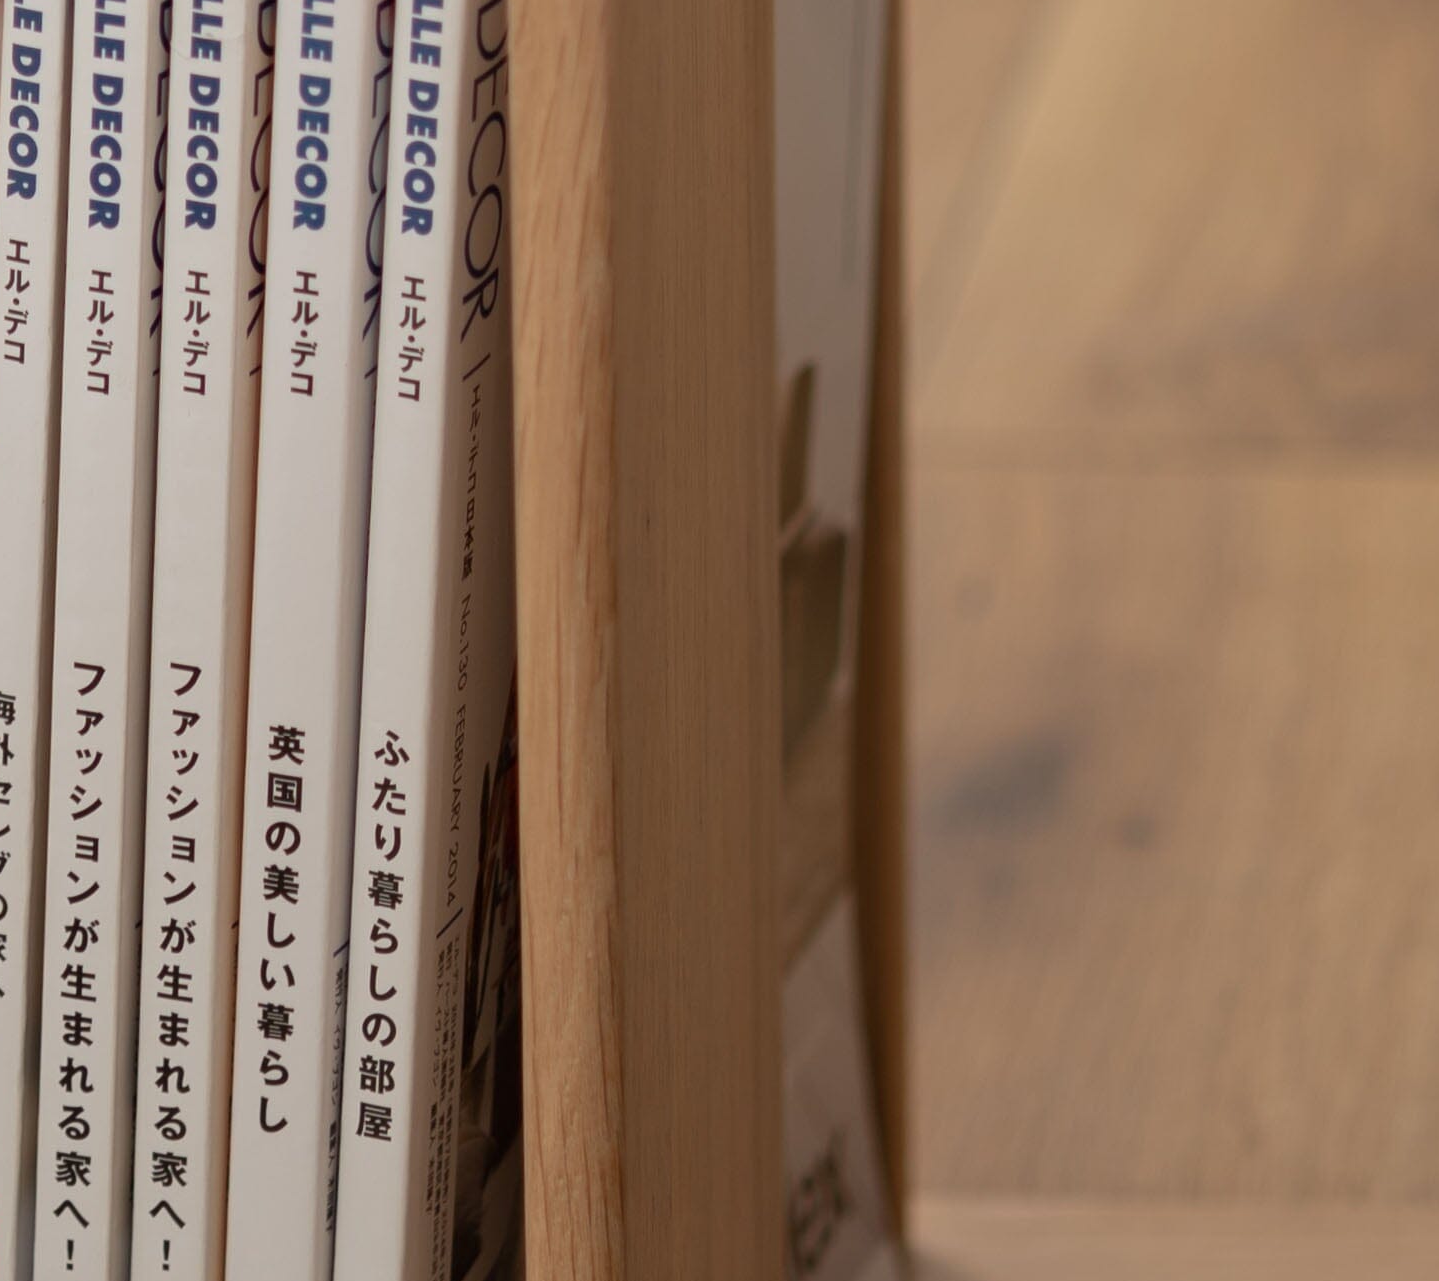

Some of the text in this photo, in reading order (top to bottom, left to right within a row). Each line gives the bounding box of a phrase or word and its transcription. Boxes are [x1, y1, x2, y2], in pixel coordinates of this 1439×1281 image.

[6, 43, 42, 201] DECOR
[88, 72, 124, 230] DECOR
[184, 73, 221, 230] DECOR
[292, 73, 332, 231] DECOR
[401, 78, 440, 236] DECOR
[3, 238, 31, 365] エル・デコ
[86, 269, 115, 396] エル・デコ
[183, 270, 211, 396] エル・デコ
[290, 270, 320, 397] エル・デコ
[397, 275, 427, 402] エル・デコ
[52, 661, 106, 1272] ファッションが生まれる家へ！
[148, 661, 203, 1272] ファッションが生まれる家へ！
[256, 724, 306, 1133] 英国の美しい暮らし
[355, 730, 410, 1142] ふたり暮らしの部屋
